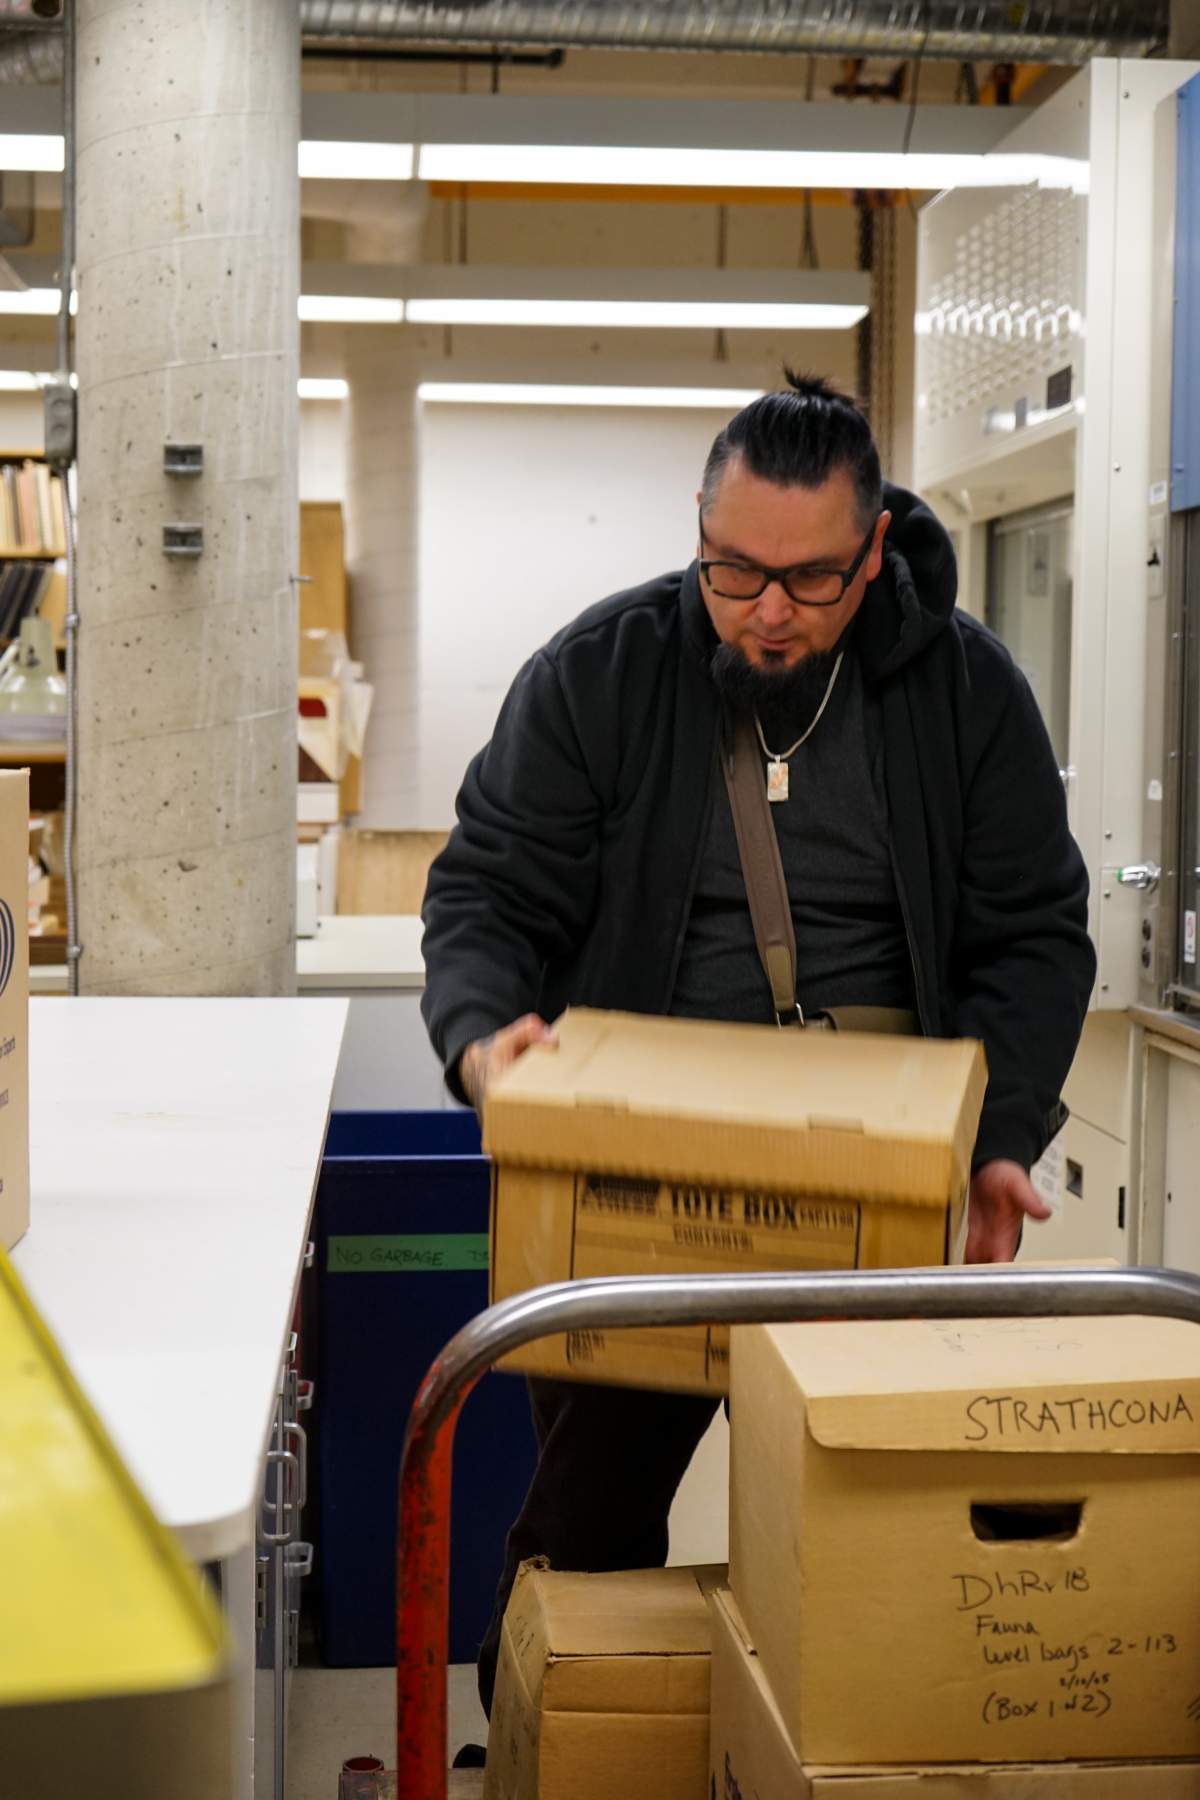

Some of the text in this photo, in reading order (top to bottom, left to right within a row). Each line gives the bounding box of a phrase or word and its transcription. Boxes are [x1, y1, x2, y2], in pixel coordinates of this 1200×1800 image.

[336, 1247, 362, 1265] NO
[369, 1247, 444, 1267] GARBAGE
[965, 1393, 1194, 1440] STRATHCONA
[976, 1614, 1039, 1637] Fauna
[1041, 1641, 1089, 1672] bags
[982, 1691, 1038, 1725] (Box
